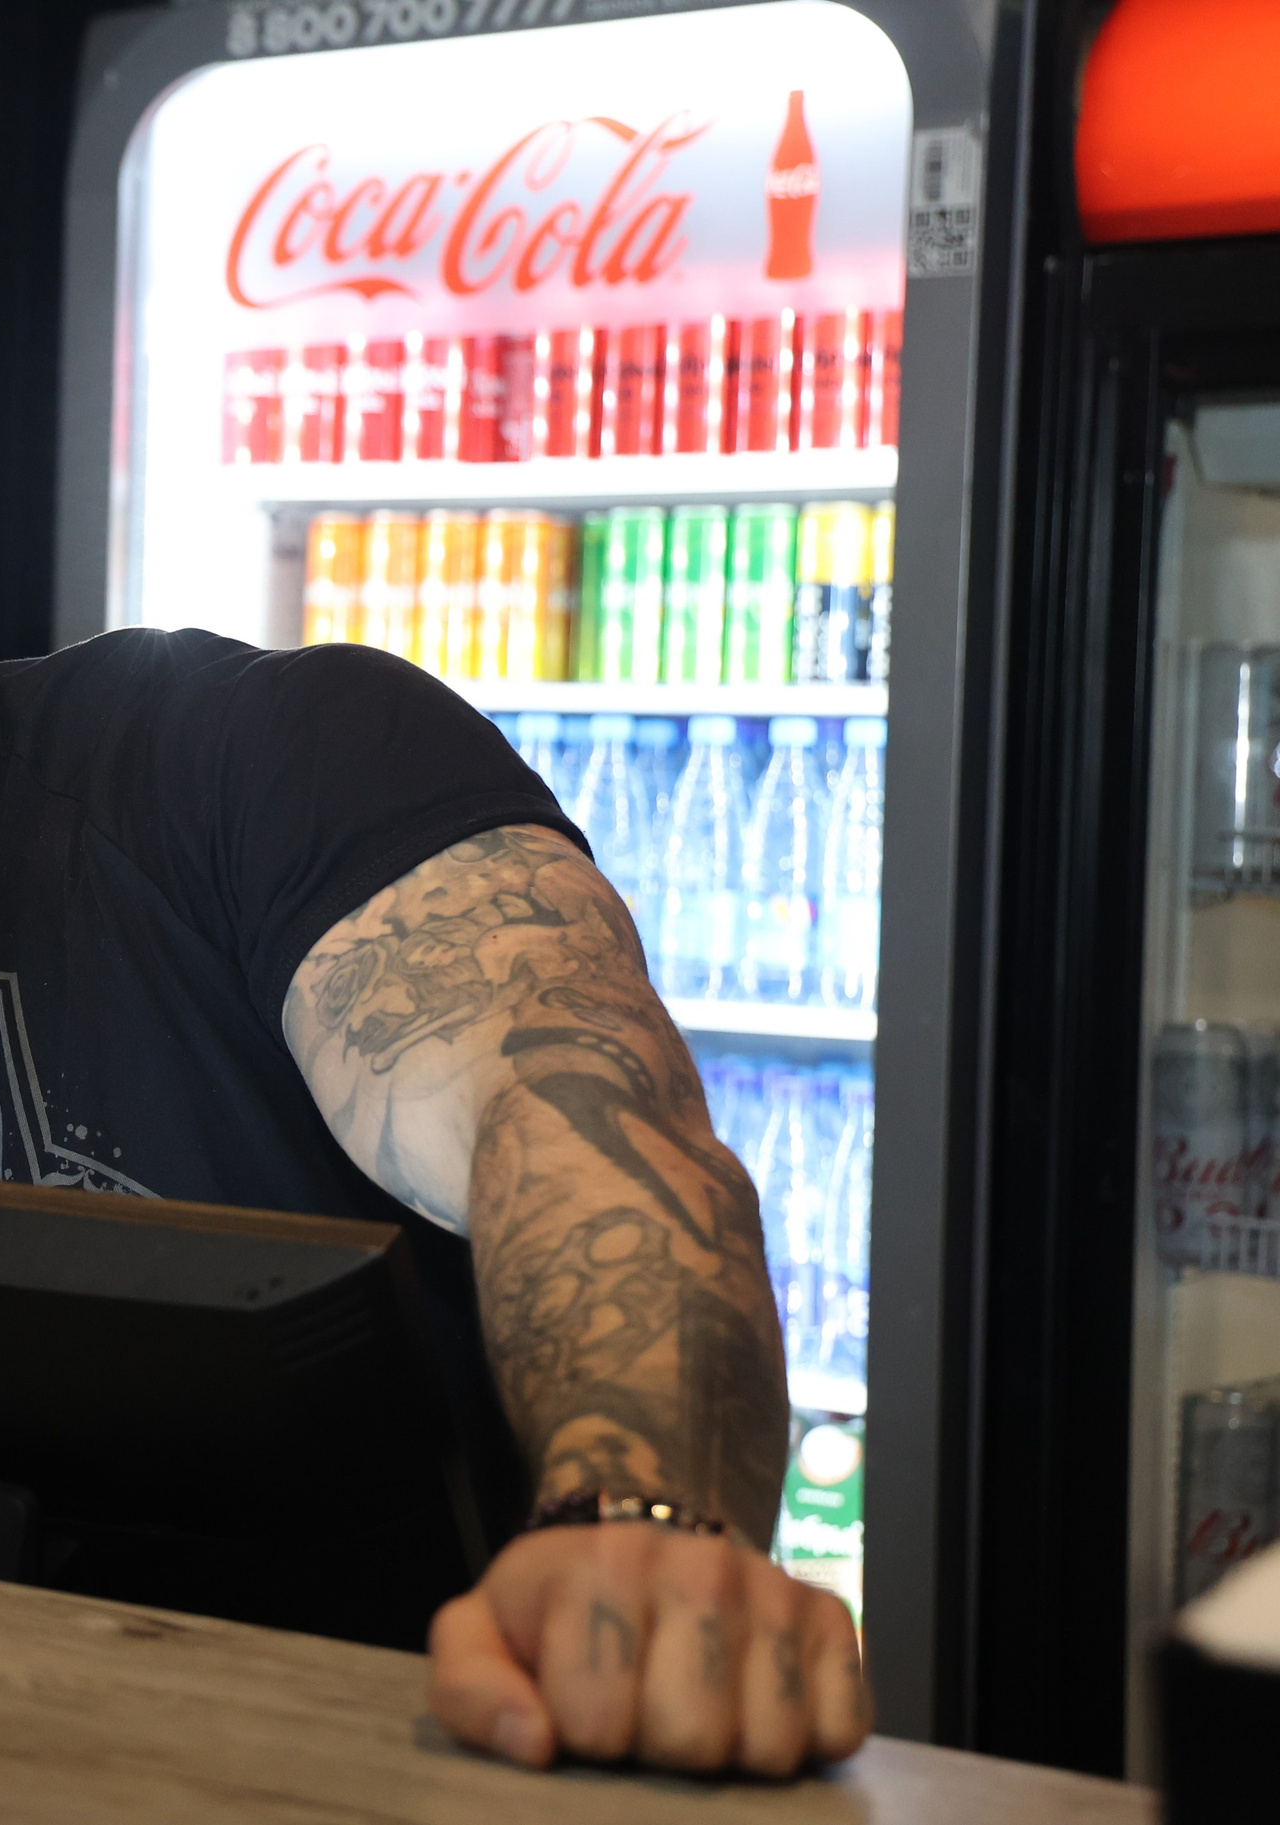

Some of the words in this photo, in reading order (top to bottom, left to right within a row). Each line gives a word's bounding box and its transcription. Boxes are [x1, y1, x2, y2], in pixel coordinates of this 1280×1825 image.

[226, 10, 258, 57] 8
[262, 3, 358, 53] 800
[363, 0, 457, 43] 700
[226, 108, 716, 309] Coca-Cola
